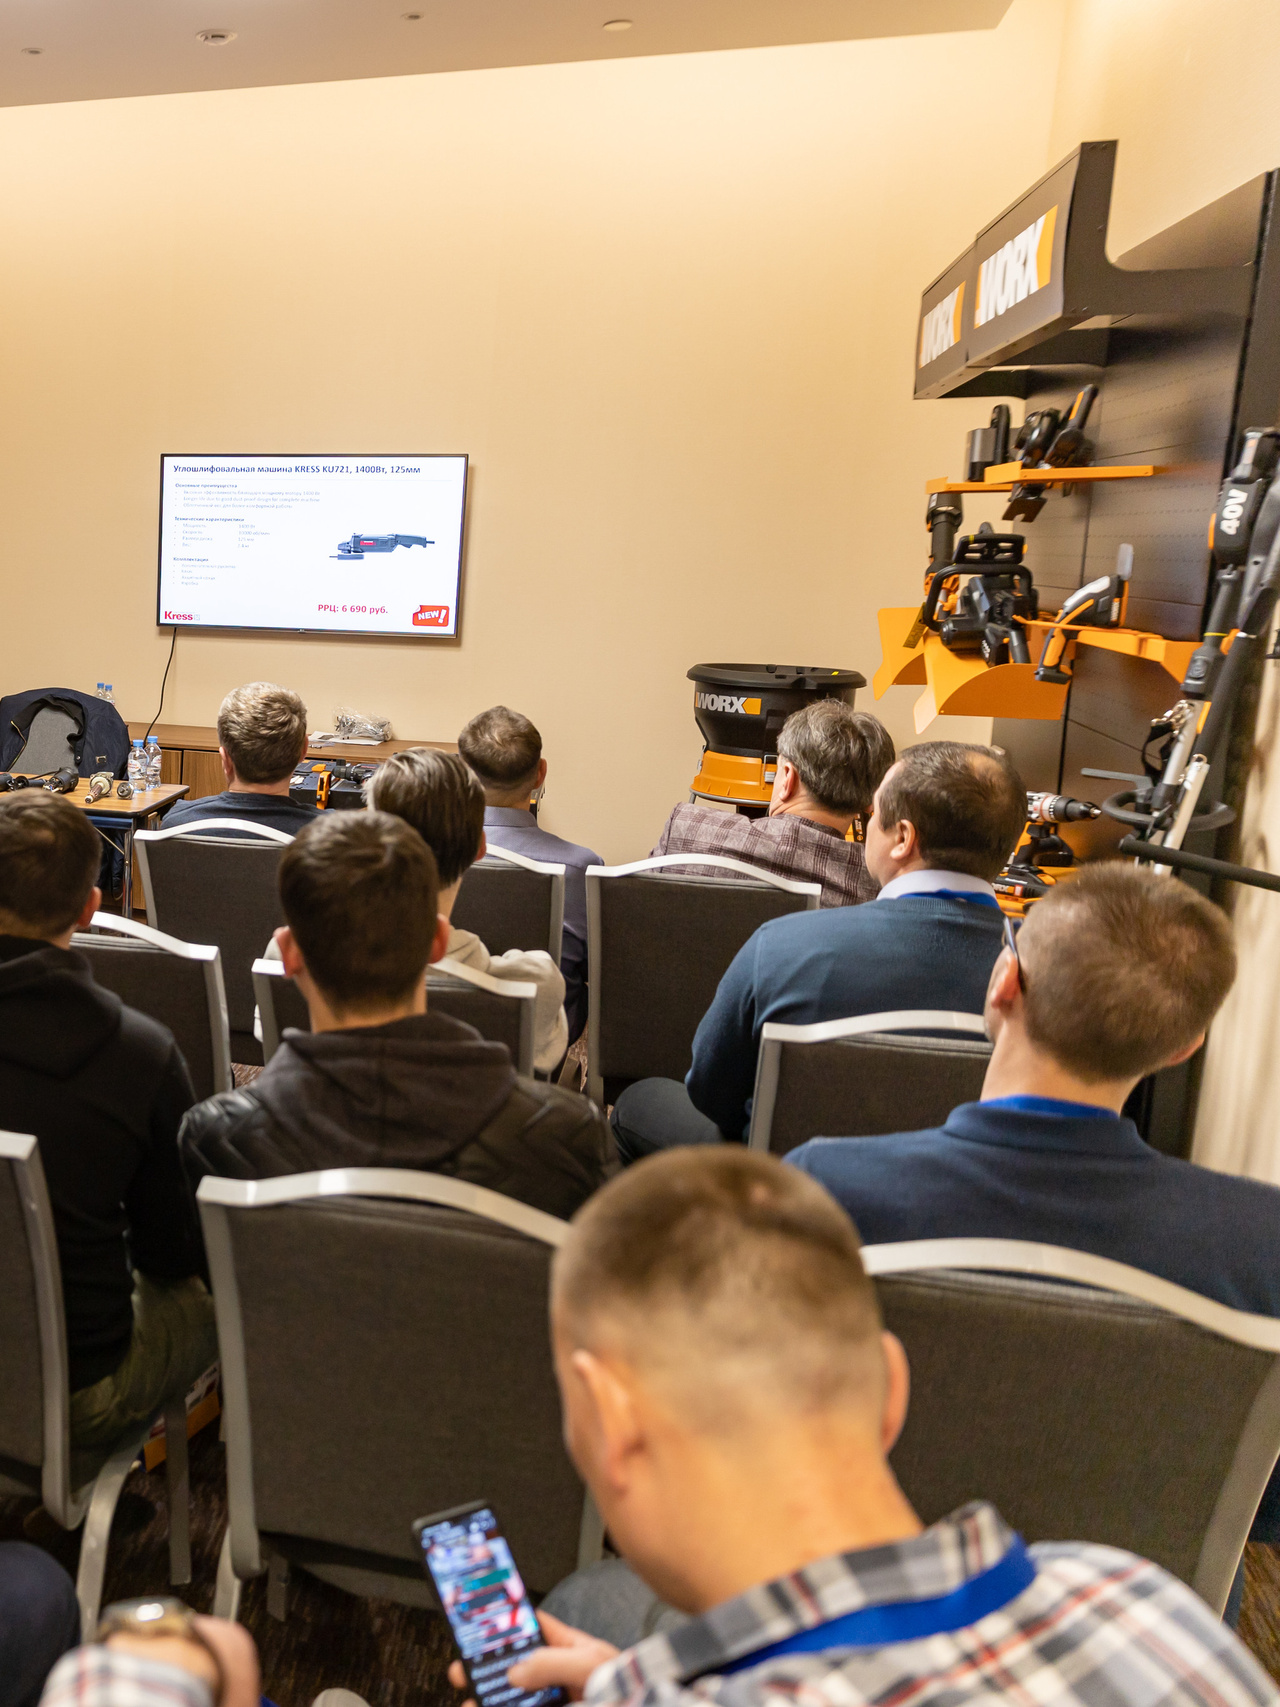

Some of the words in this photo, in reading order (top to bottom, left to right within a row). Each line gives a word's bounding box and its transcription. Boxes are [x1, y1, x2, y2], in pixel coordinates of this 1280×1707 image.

[979, 213, 1046, 326] WORX
[921, 285, 959, 367] WORX
[173, 465, 255, 474] Углошлифовальная
[322, 466, 352, 475] KU721,
[355, 466, 388, 475] 1400Вт,
[390, 466, 421, 474] 125мм
[1220, 488, 1248, 536] 40V
[164, 611, 194, 621] Kress
[317, 604, 339, 613] РРЦ:
[341, 605, 348, 613] 6
[349, 605, 367, 613] 690
[369, 605, 388, 615] руб.
[697, 692, 747, 714] WORX
